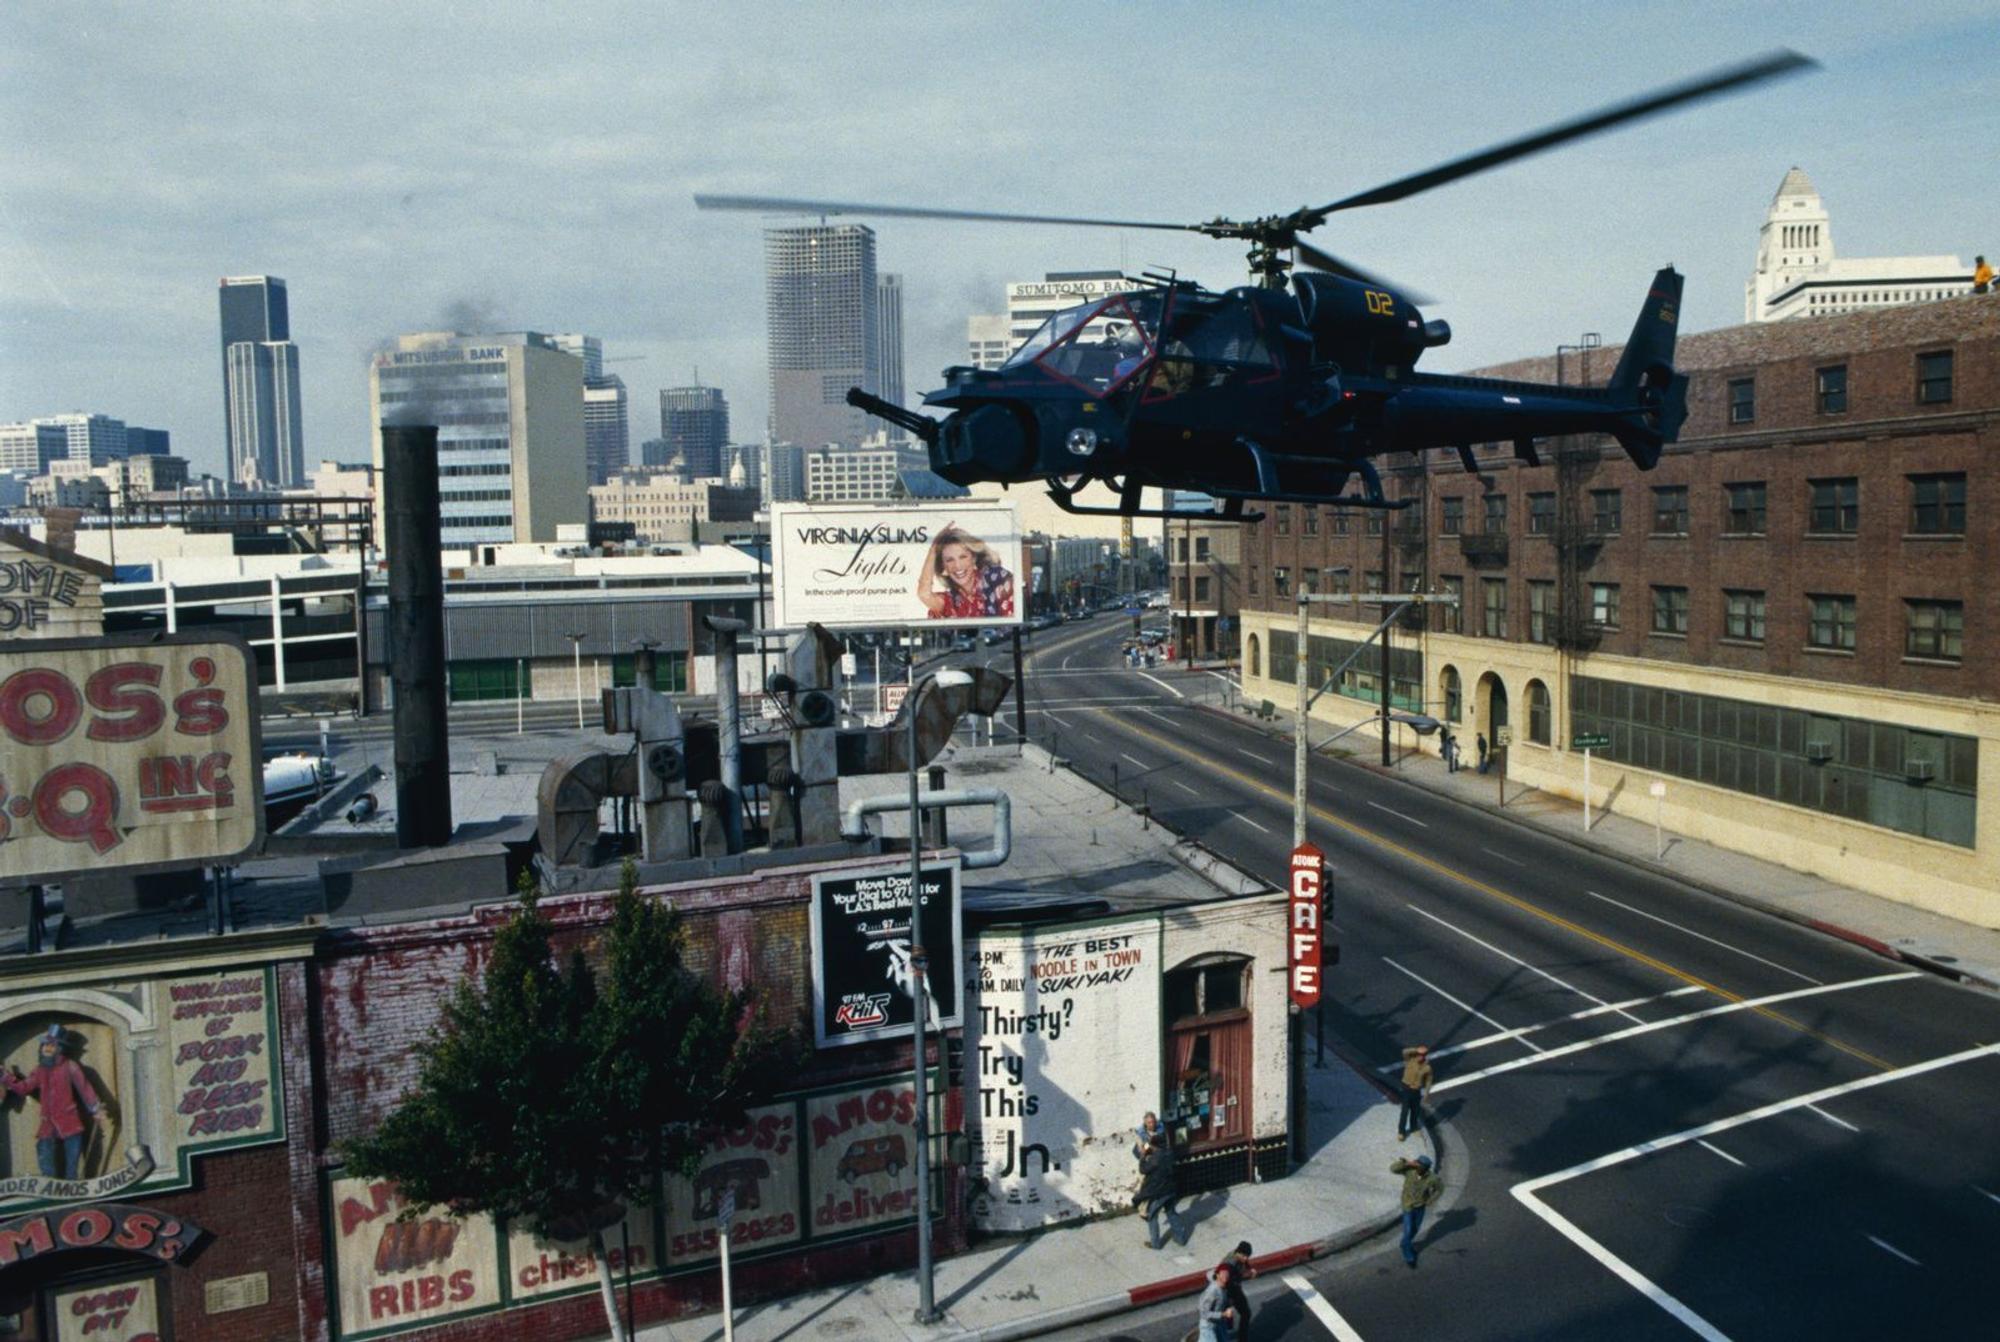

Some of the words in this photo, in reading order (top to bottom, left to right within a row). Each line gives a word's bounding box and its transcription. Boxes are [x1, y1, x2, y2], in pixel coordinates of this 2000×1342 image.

[1016, 281, 1096, 295] SUMITOMO
[1104, 278, 1146, 292] BANK
[470, 347, 505, 360] BANK
[797, 527, 874, 545] VIRGINIA
[878, 526, 928, 544] SLIMS
[0, 599, 49, 631] OF
[138, 752, 235, 799] INC
[832, 894, 857, 905] Your
[859, 889, 880, 901] Dial
[881, 889, 892, 899] to
[894, 886, 906, 898] 97
[925, 882, 940, 894] for
[855, 879, 885, 892] Move
[887, 876, 912, 888] Dow
[873, 898, 896, 910] Best
[897, 891, 928, 908] Muc
[1293, 870, 1319, 993] CAFE
[1043, 942, 1077, 958] THE
[1085, 935, 1133, 953] BEST
[977, 965, 993, 980] to
[1030, 959, 1078, 979] NOODLE
[1085, 960, 1098, 972] IN
[1104, 949, 1141, 968] TOWN
[1001, 978, 1027, 993] DAILY
[1038, 967, 1134, 994] SUKIYAKI
[205, 1016, 234, 1036] OF
[978, 998, 1074, 1040] Thirsty?
[175, 1033, 264, 1065] PORK
[190, 1058, 248, 1086] AND
[978, 1046, 1024, 1085] Try
[178, 1079, 268, 1115] BEEF
[980, 1088, 1040, 1118] This
[188, 1104, 264, 1136] RIBS
[812, 1088, 918, 1149] AMOS
[40, 1180, 89, 1197] AMOS
[95, 1168, 138, 1195] JONES
[816, 1188, 918, 1226] deliver
[72, 1286, 139, 1316] OPEN
[368, 1269, 475, 1320] RIBS
[82, 1309, 130, 1335] PIT
